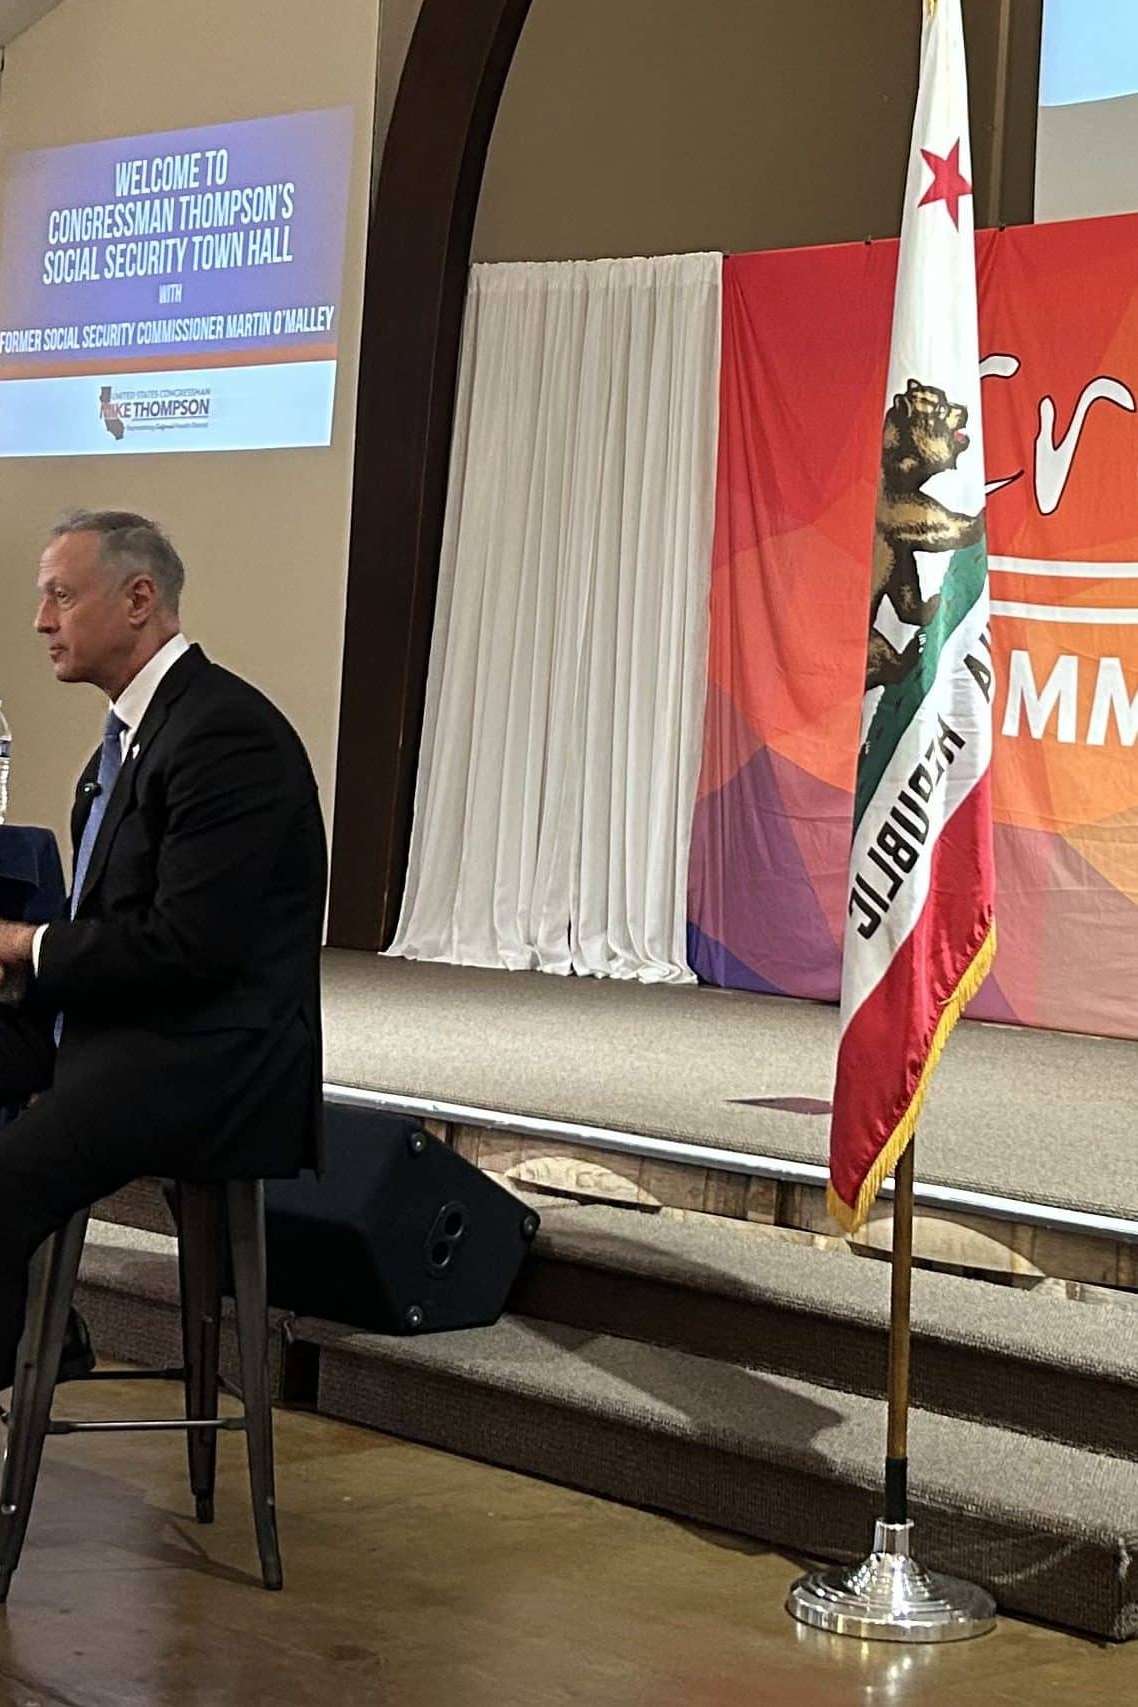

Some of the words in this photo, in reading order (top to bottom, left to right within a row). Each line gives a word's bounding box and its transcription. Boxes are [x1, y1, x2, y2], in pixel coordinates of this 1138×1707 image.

[115, 152, 202, 197] WELCOME
[205, 149, 228, 187] TO
[48, 197, 174, 244] CONGRESSMAN
[179, 182, 295, 231] THOMPSON'S
[43, 246, 100, 285] SOCIAL
[104, 237, 189, 279] SECURITY
[192, 231, 244, 271] TOWN
[247, 225, 293, 266] HALL
[159, 283, 183, 304] WITH
[43, 327, 80, 351] SOCIAL
[82, 322, 136, 349] SECURITY
[137, 315, 224, 345] COMMISSIONER
[226, 311, 272, 339] MARTIN
[273, 305, 335, 335] O'MALLEY
[133, 398, 210, 418] THOMPSON
